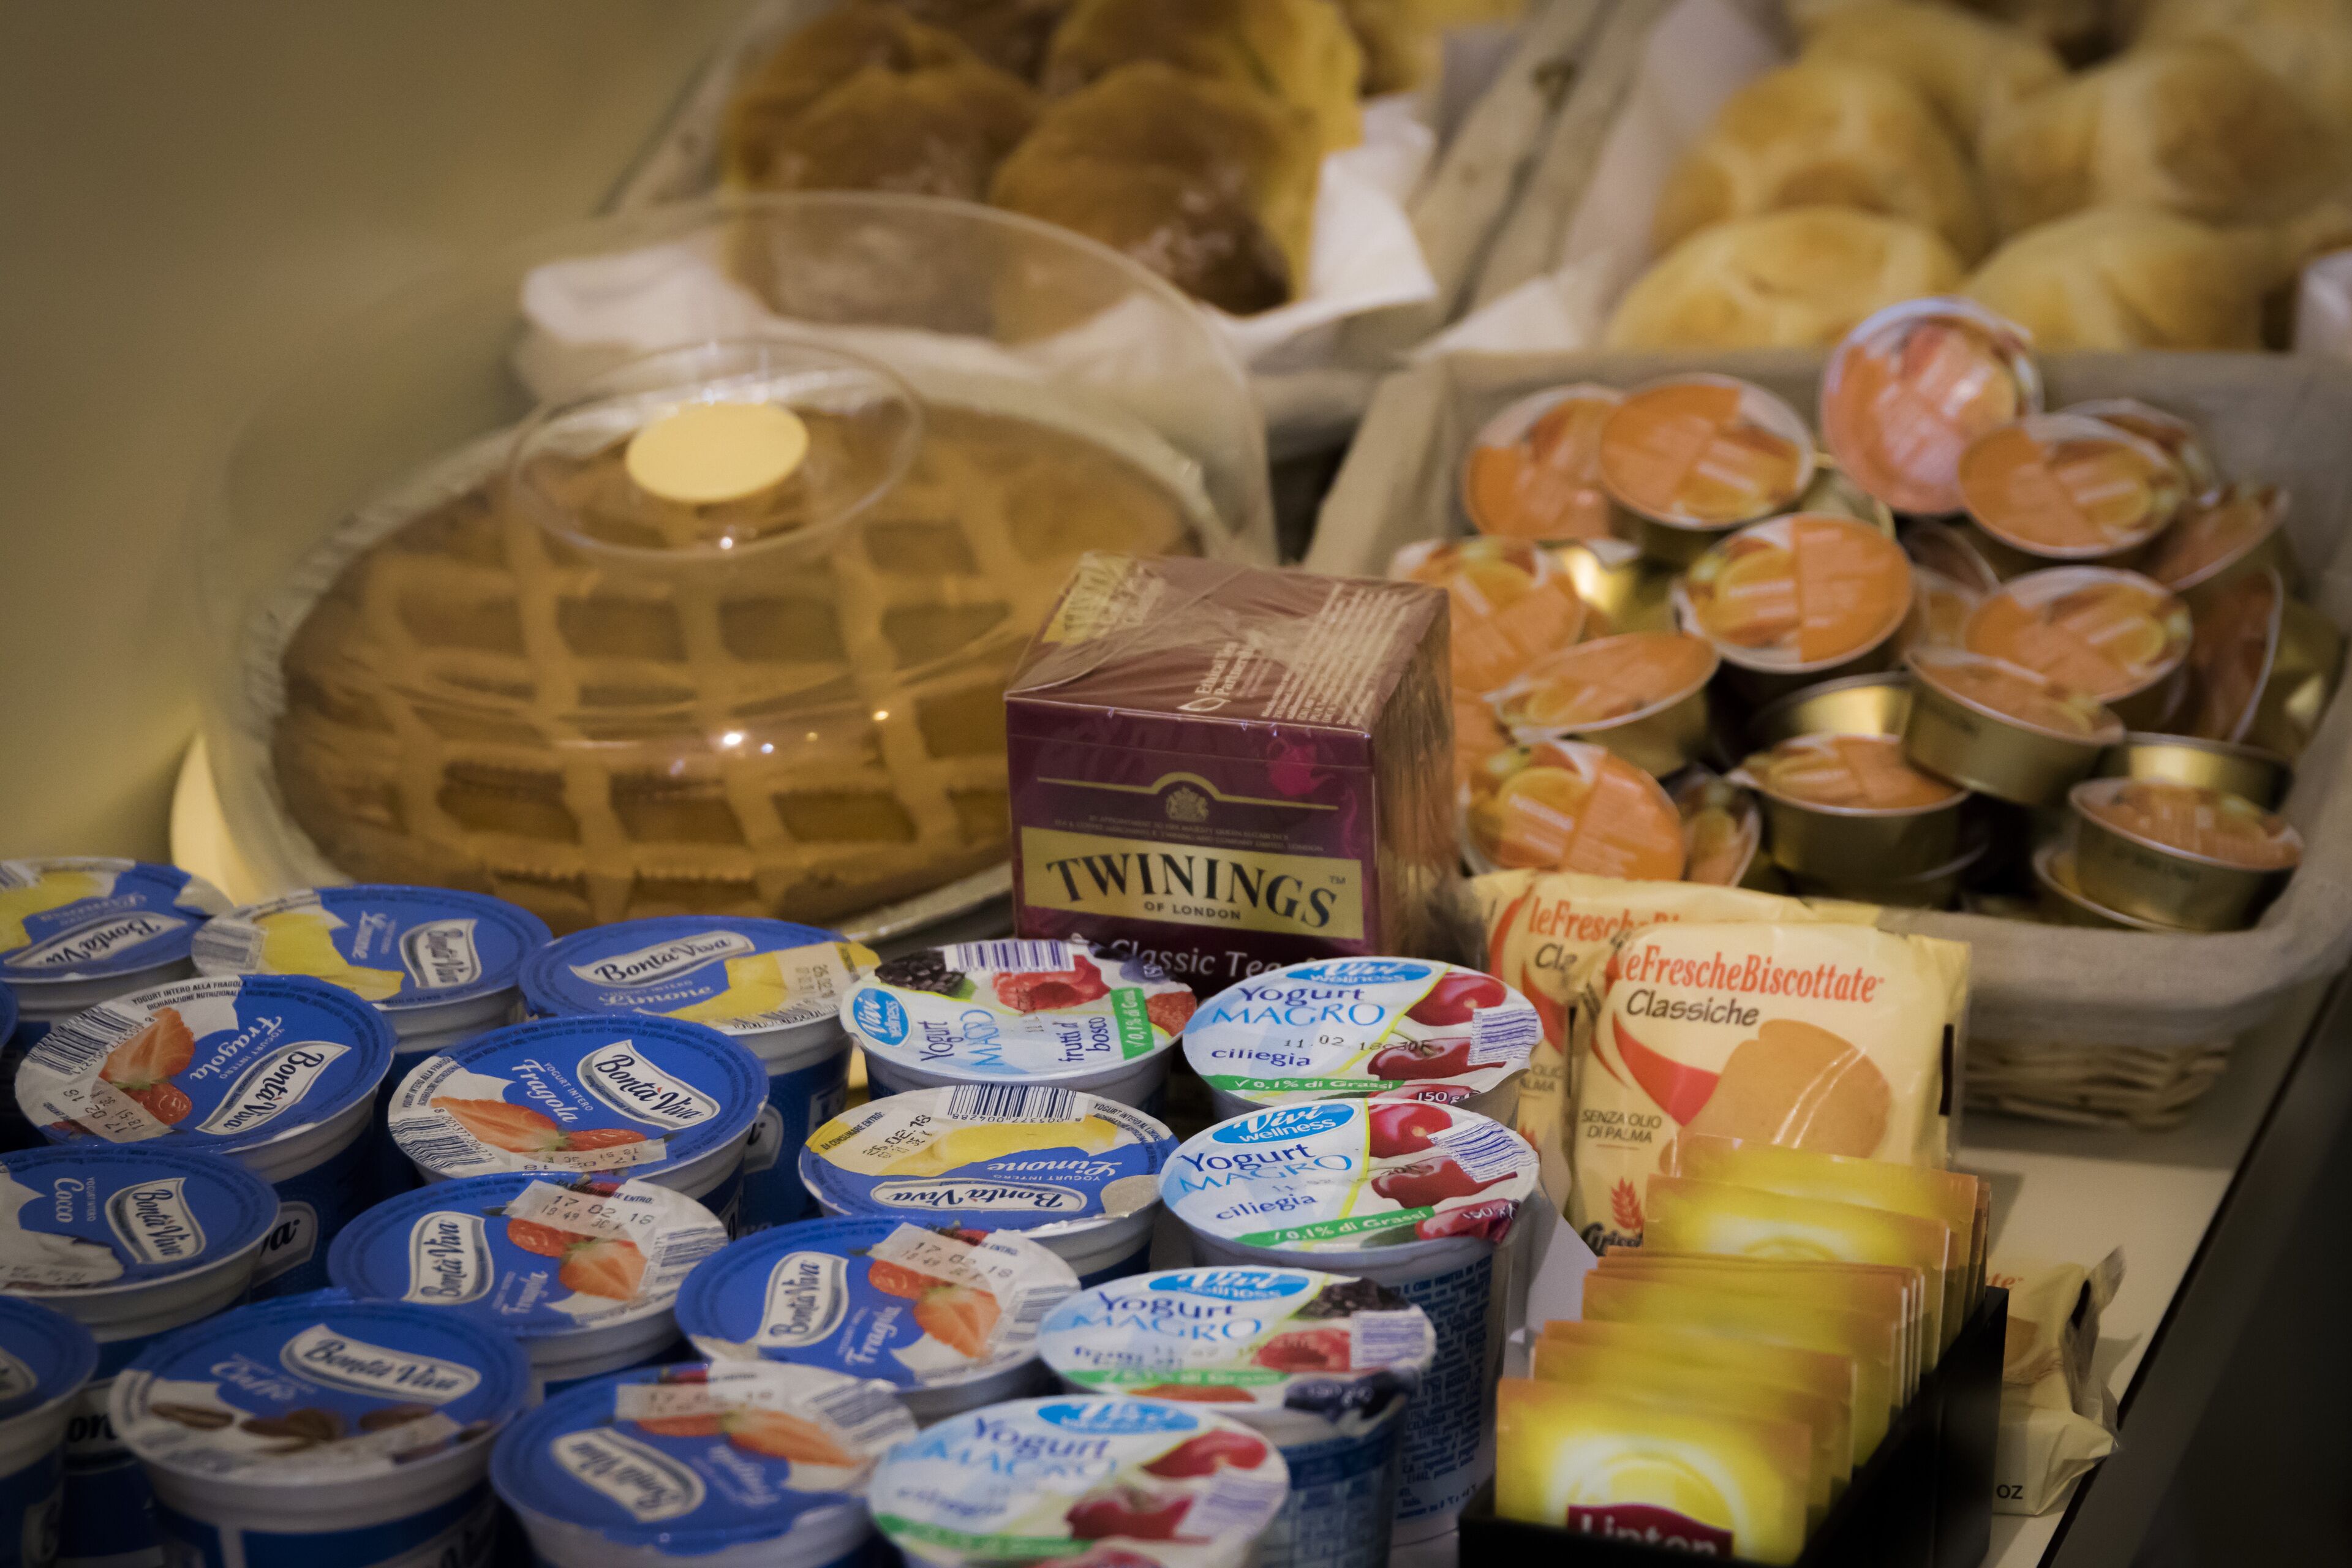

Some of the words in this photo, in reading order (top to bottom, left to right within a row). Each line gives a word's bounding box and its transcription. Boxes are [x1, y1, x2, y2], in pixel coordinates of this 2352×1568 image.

[1046, 852, 1336, 928] TWININGS
[1144, 901, 1164, 911] OF
[1172, 905, 1241, 919] LONDON
[1111, 938, 1216, 976] Classic
[1623, 944, 1875, 1003] eFrescheBiscottate
[131, 990, 162, 1005] YOGURT
[163, 985, 190, 997] INTERO
[192, 982, 211, 991] ALLA
[213, 980, 247, 989] FRAGOLA
[146, 995, 195, 1010] DICHIARAZIONE
[1237, 985, 1365, 1007] Yogurt
[1211, 1003, 1386, 1027] MAGRO
[1627, 988, 1760, 1027] Classiche
[918, 1020, 964, 1061] Yogurt
[1085, 1016, 1111, 1052] bosco
[189, 1016, 282, 1080] Fragola
[1211, 1049, 1311, 1068] ciliegia
[219, 1055, 251, 1079] INTERO
[255, 1050, 325, 1101] Bontà
[421, 1069, 434, 1084] ALLA
[511, 1058, 579, 1123] Fragola
[543, 1061, 571, 1089] YOGURT
[567, 1087, 594, 1112] INTERO
[594, 1054, 663, 1102] Bontà
[649, 1091, 701, 1120] Viva
[1305, 1080, 1324, 1088] di
[1330, 1080, 1393, 1090] Grassi
[1417, 1091, 1448, 1102] 150
[223, 1102, 277, 1129] Viva
[952, 1112, 1005, 1123] 004288
[1093, 1102, 1120, 1118] YOGURT
[1120, 1112, 1140, 1128] INTERO
[1233, 1106, 1324, 1135] Vivi
[1581, 1109, 1624, 1125] SENZA
[1629, 1114, 1663, 1129] OLIO
[820, 1142, 832, 1151] DA
[829, 1124, 865, 1147] CONSUMARE
[864, 1111, 885, 1128] ENTRO:
[1238, 1118, 1337, 1144] wellness
[1588, 1125, 1603, 1139] DI
[1605, 1126, 1653, 1144] PALMA
[988, 1159, 1123, 1177] Limone
[1176, 1143, 1317, 1173] Yogurt
[1178, 1154, 1353, 1193] MAGRO
[53, 1177, 85, 1223] Cocco
[132, 1189, 173, 1227] Bontà
[552, 1194, 580, 1207] 17
[587, 1204, 617, 1219] 02
[623, 1193, 655, 1205] ENTRO:
[889, 1189, 963, 1207] Viva
[967, 1189, 1064, 1209] Bontà
[1215, 1193, 1319, 1221] ciliegia
[1338, 1221, 1355, 1234] di
[1362, 1210, 1427, 1229] Grassi
[1099, 1292, 1234, 1319] Yogurt
[1071, 1315, 1262, 1342] MAGRO
[974, 1416, 1110, 1460] Yogurt
[1996, 1484, 2023, 1499] OZ
